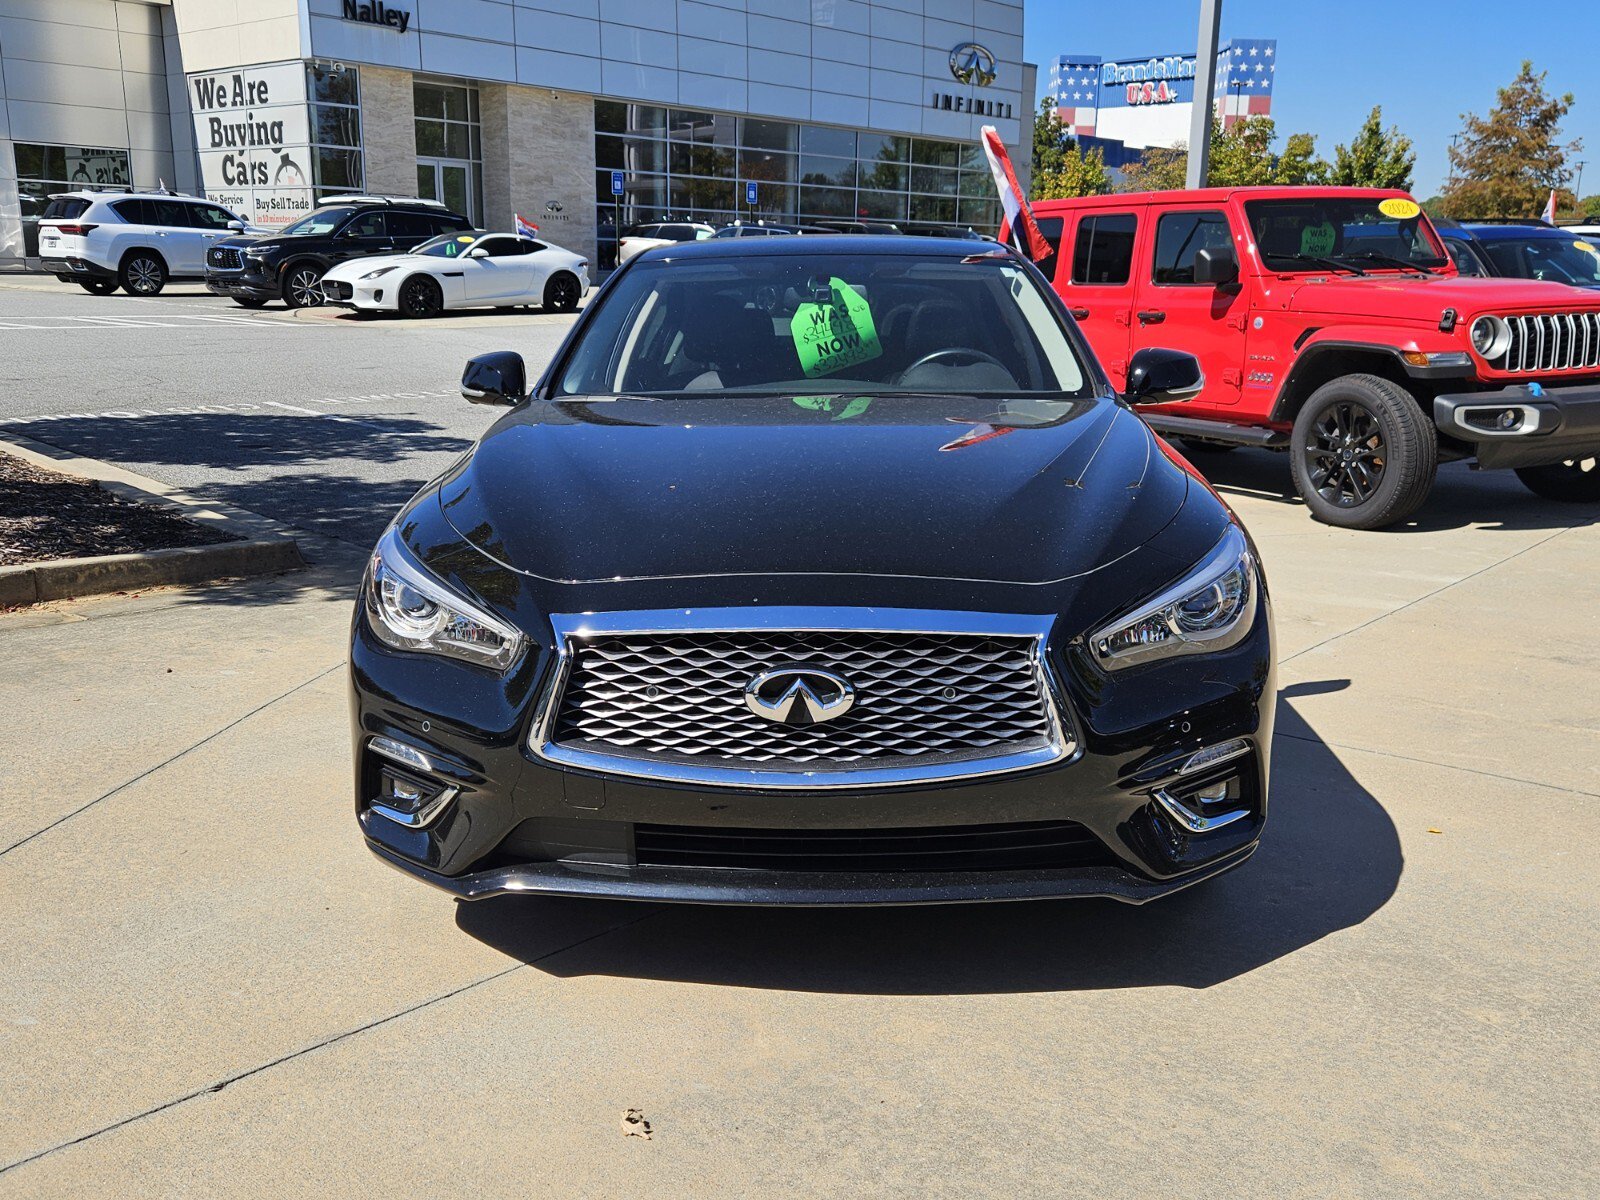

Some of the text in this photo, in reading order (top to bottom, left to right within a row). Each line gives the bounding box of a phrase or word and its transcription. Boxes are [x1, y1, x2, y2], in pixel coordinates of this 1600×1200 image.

[343, 0, 410, 33] Nalley
[1103, 57, 1197, 84] BrandsMar
[194, 75, 268, 109] We Are
[933, 93, 1012, 119] INFINITI
[209, 112, 284, 154] Buying
[222, 154, 269, 186] Cars
[219, 193, 244, 206] Service
[256, 197, 310, 213] Buy Sell Trade
[1385, 203, 1413, 214] 2024
[1310, 229, 1328, 238] WAS
[1308, 243, 1327, 252] NOW
[810, 304, 849, 326] WAS
[816, 333, 860, 357] NOW
